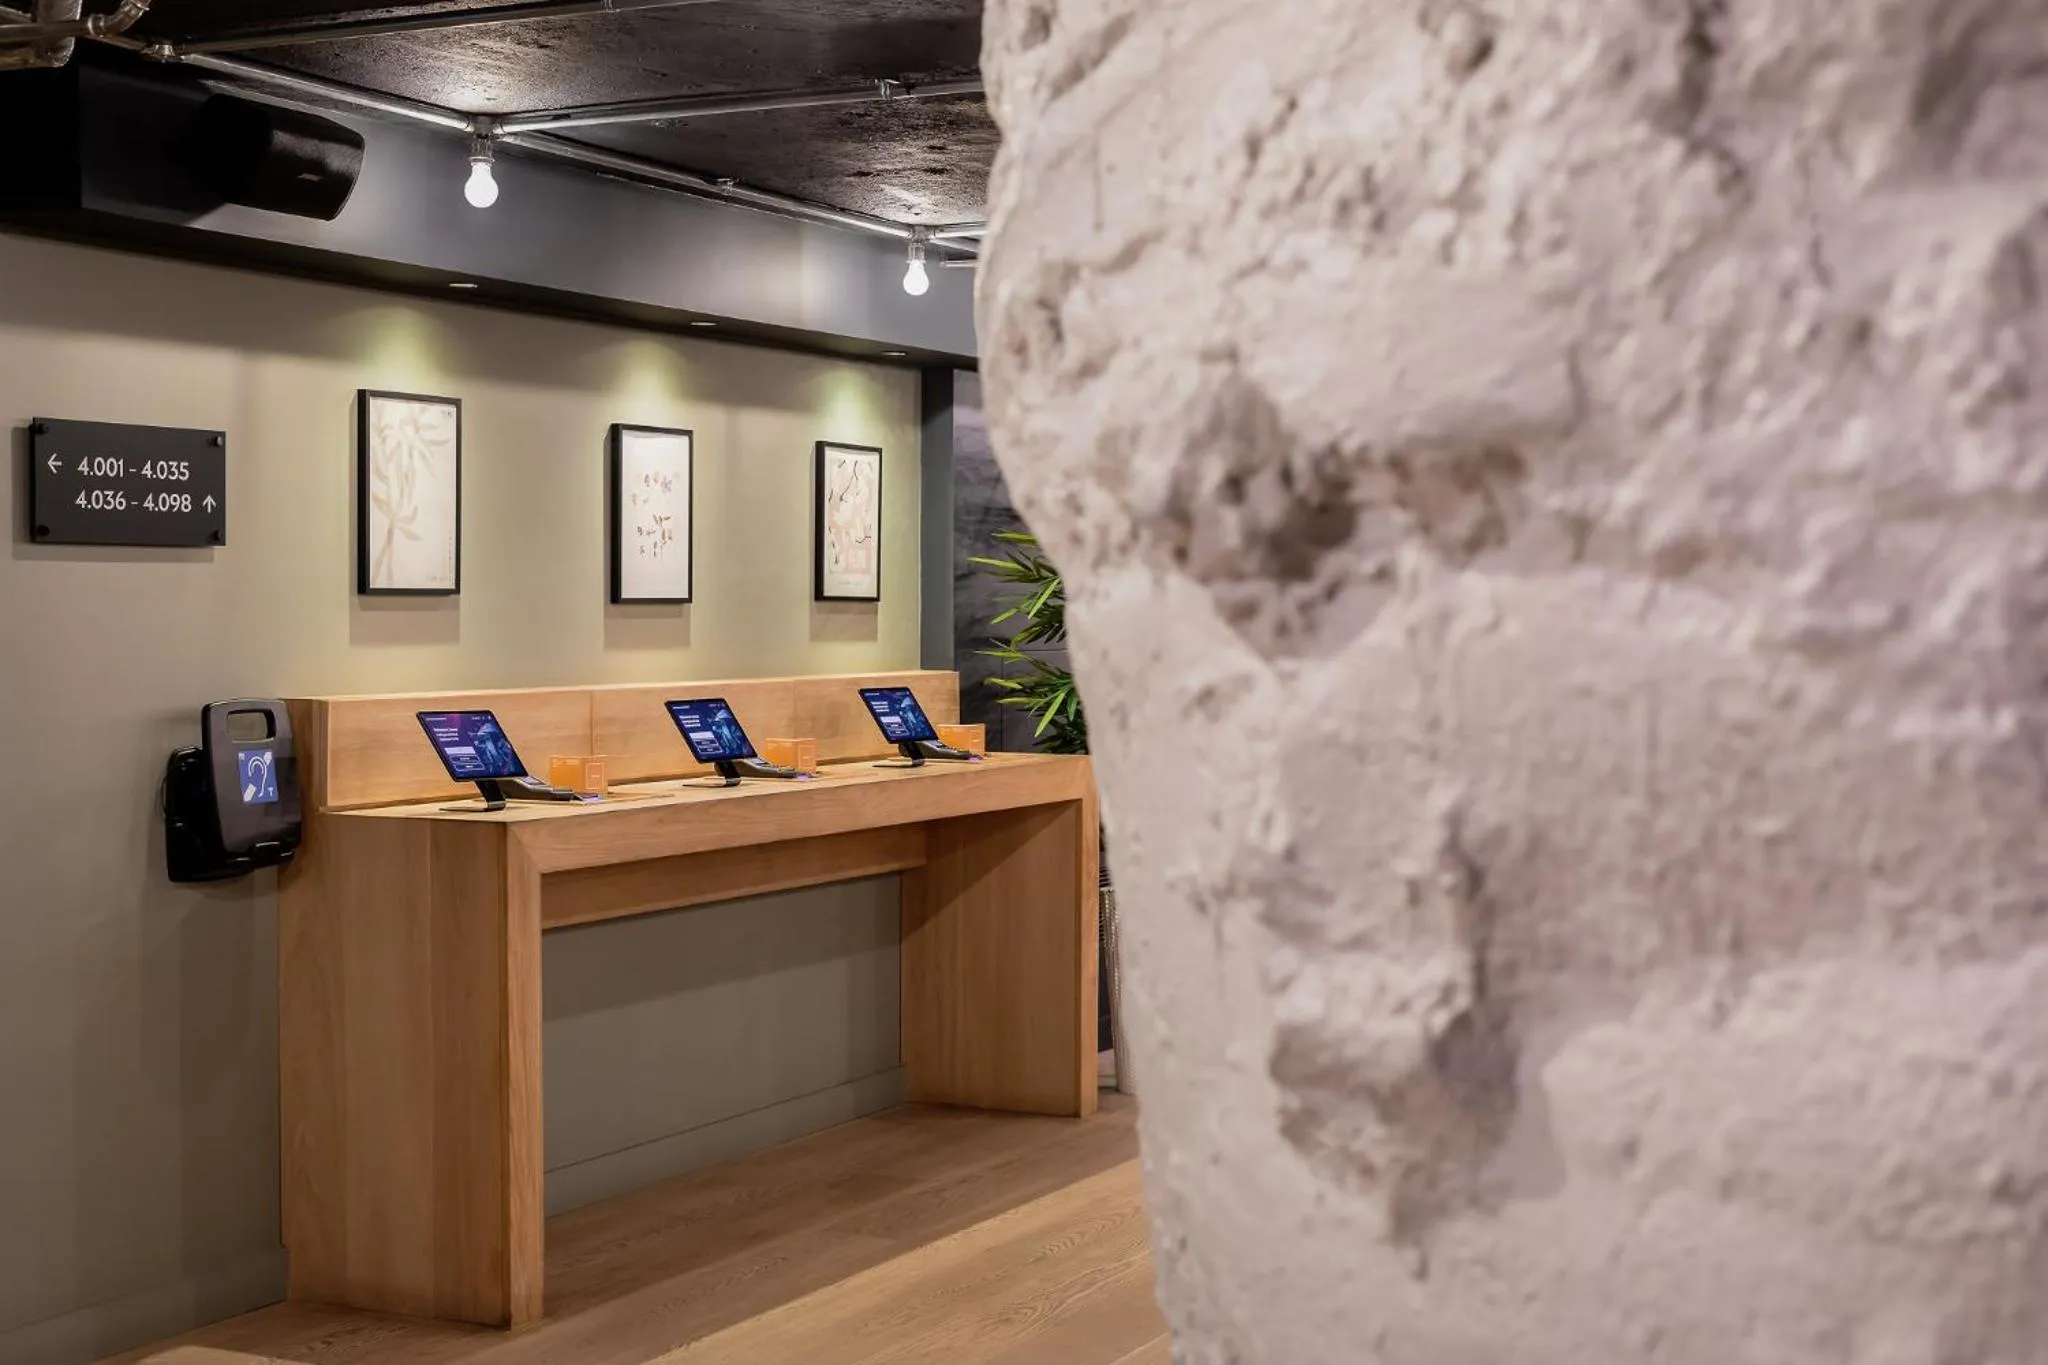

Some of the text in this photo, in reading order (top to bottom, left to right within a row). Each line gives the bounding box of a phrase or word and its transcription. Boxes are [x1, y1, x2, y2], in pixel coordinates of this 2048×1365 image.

[77, 456, 124, 478] 4.001
[141, 459, 190, 481] 4.035
[75, 489, 127, 511] 4.036
[142, 492, 192, 513] 4.098
